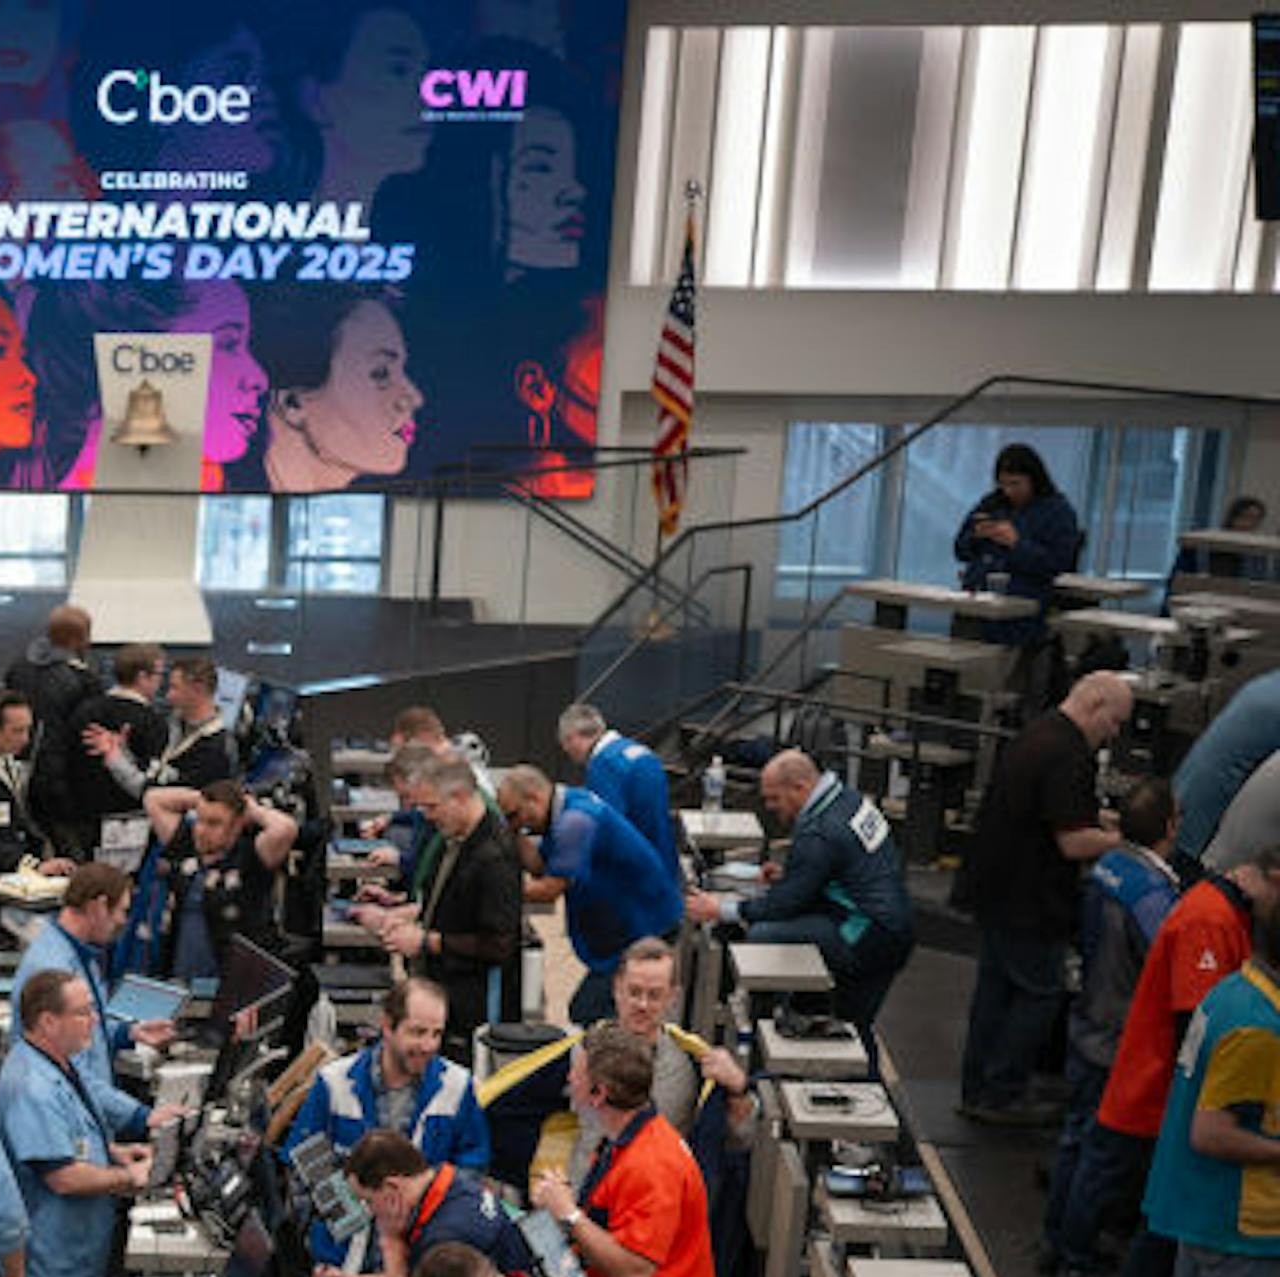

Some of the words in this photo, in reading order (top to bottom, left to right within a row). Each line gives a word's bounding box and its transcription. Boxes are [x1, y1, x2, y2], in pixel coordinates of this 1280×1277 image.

[97, 69, 251, 123] Cboe
[419, 69, 528, 108] CWI
[100, 172, 247, 191] CELEBRATING
[183, 244, 291, 280] DAY
[297, 243, 416, 281] 2025
[112, 343, 196, 373] Cboe
